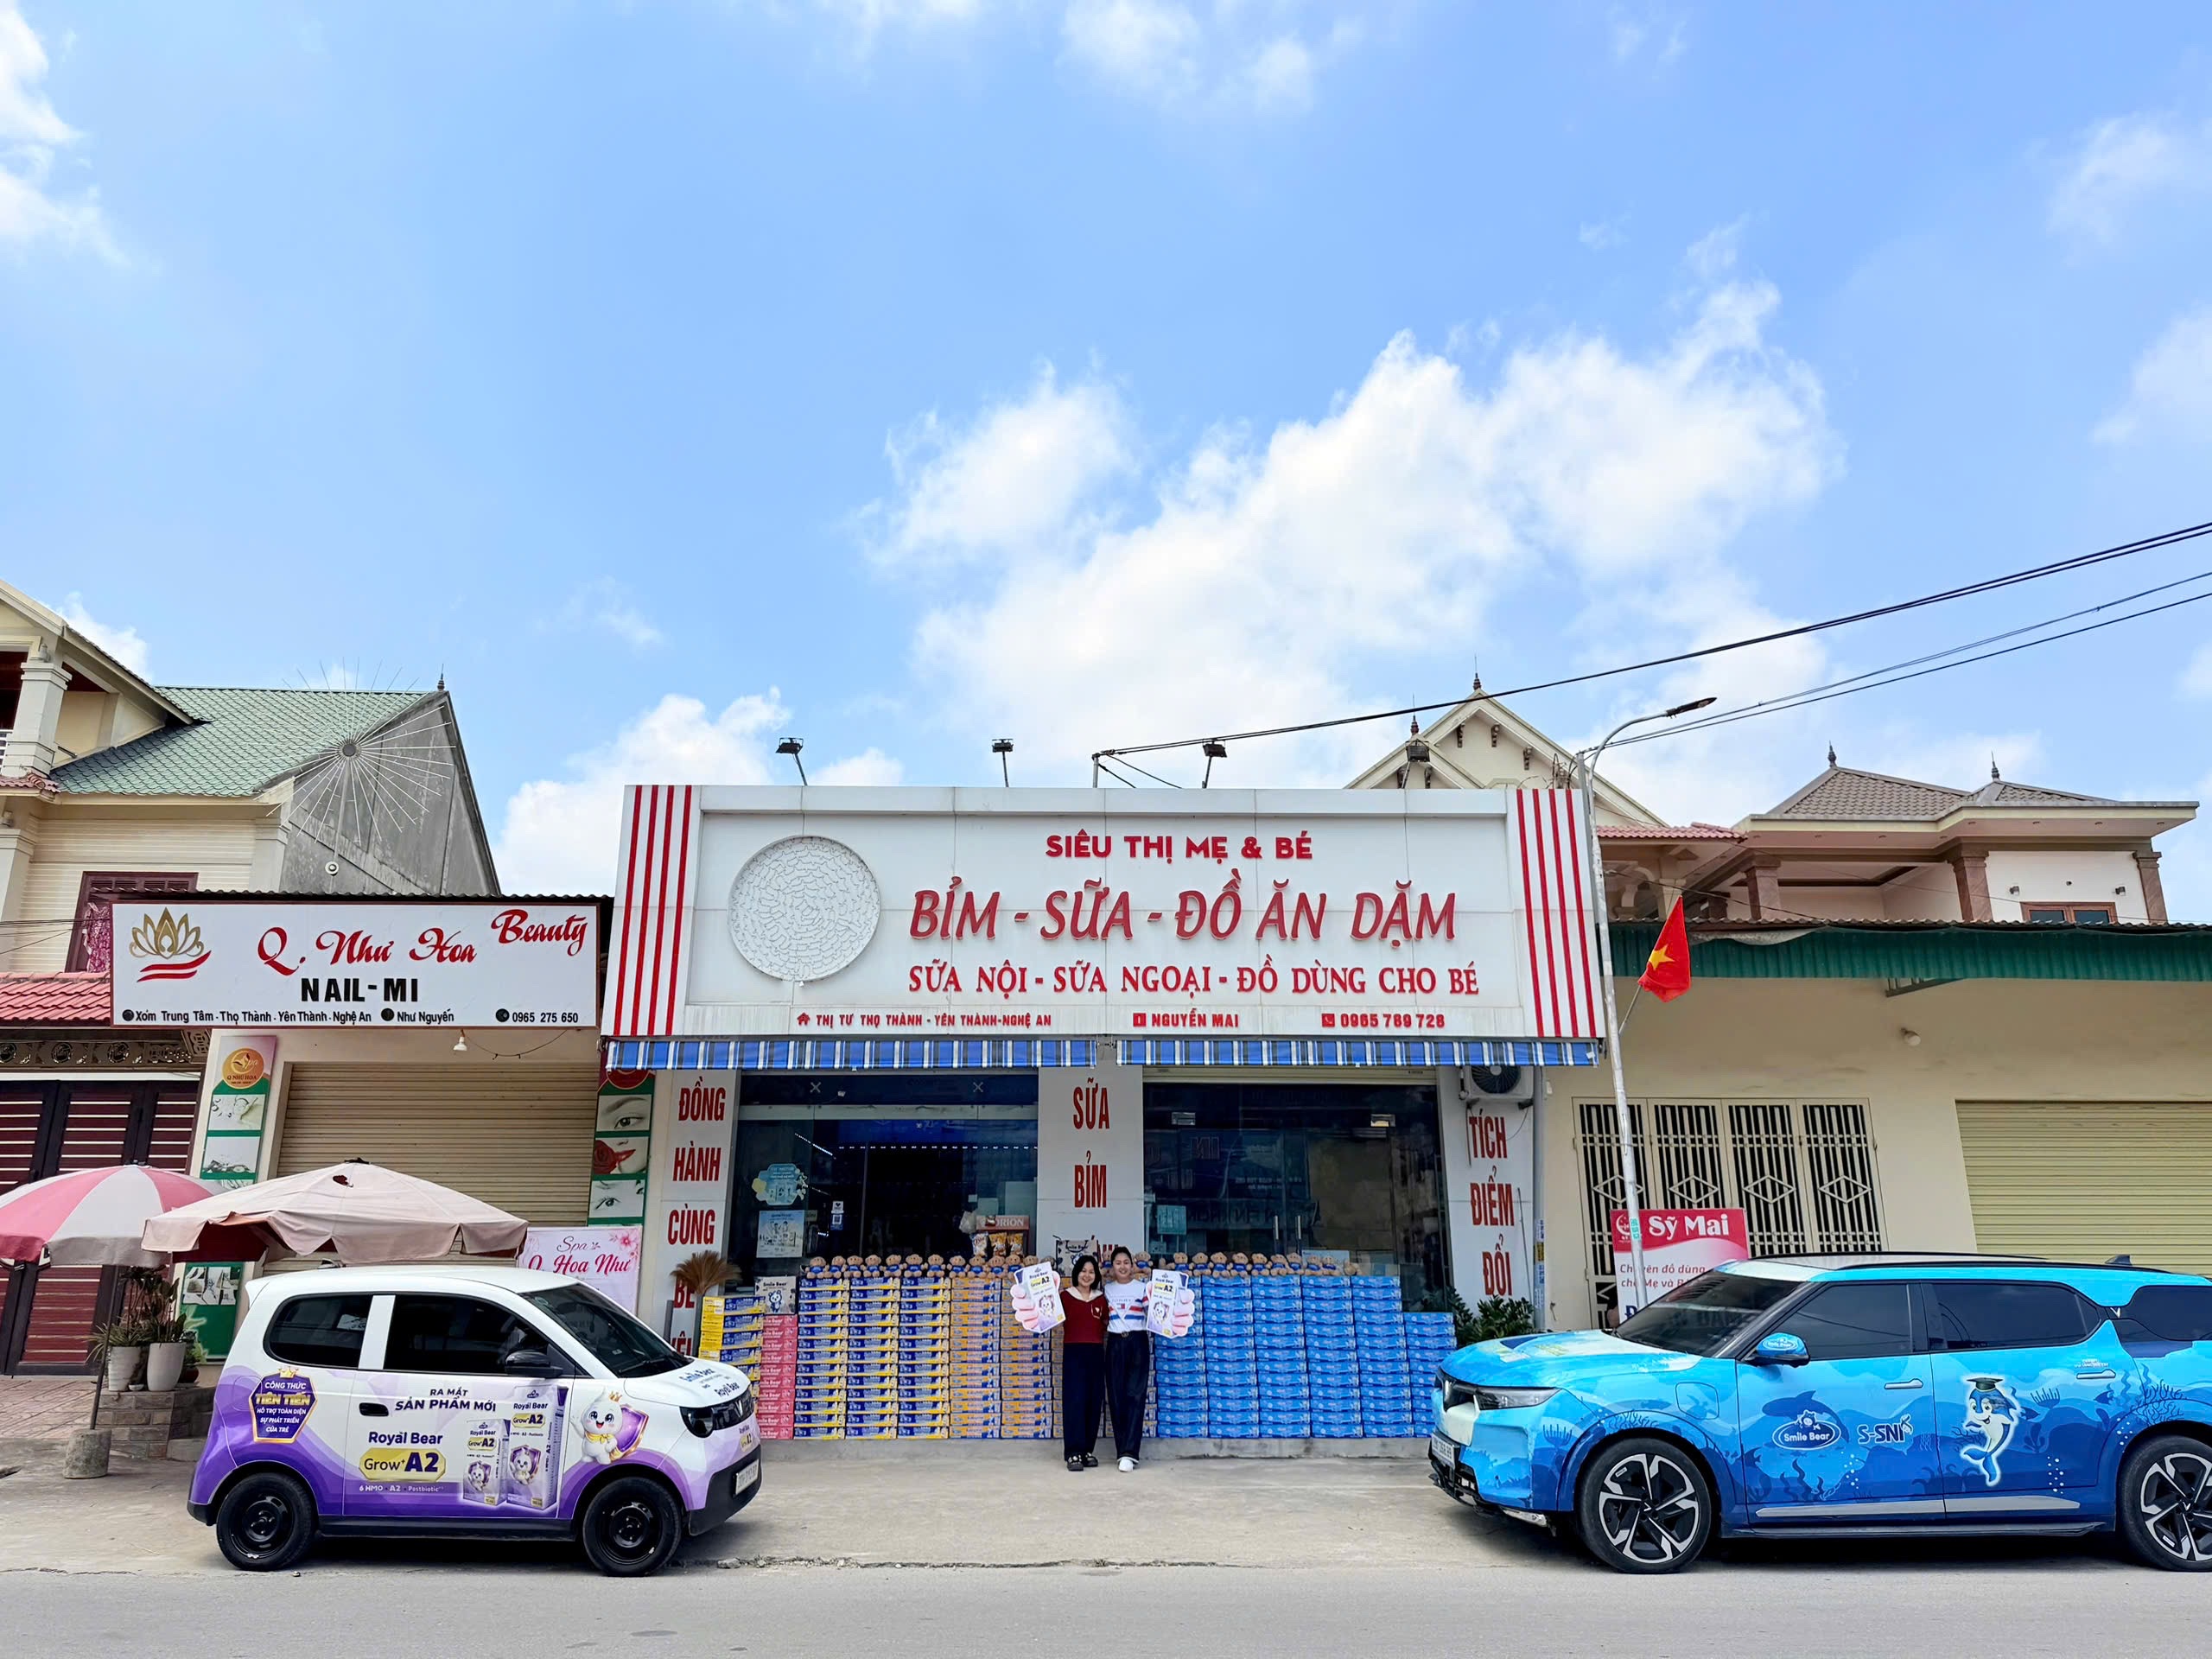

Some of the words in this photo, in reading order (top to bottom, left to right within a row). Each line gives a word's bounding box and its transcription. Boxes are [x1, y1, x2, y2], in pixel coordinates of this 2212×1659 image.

[1046, 829, 1113, 859] SIÊU
[1123, 836, 1173, 865] THỊ
[1185, 836, 1229, 865] MẸ
[1241, 836, 1262, 860] &
[1274, 830, 1313, 861] BÉ
[909, 875, 1001, 941] BỈM
[1039, 877, 1134, 941] SỮA
[1174, 868, 1243, 941] ĐỒ
[1255, 878, 1327, 941] ĂN
[1350, 880, 1457, 949] DẶM
[315, 931, 394, 966] Như
[409, 927, 478, 964] Hoa
[491, 908, 588, 957] Beauty
[909, 958, 963, 993] SỮA
[976, 959, 1028, 1001] NỘI
[1053, 960, 1108, 994] SỮA
[1121, 965, 1211, 999] NGOẠI
[1237, 955, 1279, 994] ĐỒ
[1291, 961, 1367, 995] DÙNG
[1378, 966, 1437, 995] CHO
[1448, 962, 1480, 996] BÉ
[161, 1010, 190, 1025] Trung
[193, 1009, 214, 1022] Tâm
[219, 1010, 239, 1026] Thọ
[241, 1010, 272, 1022] Thành
[277, 1010, 296, 1022] Yên
[296, 1010, 327, 1022] Thành
[333, 1010, 357, 1026] Nghệ
[359, 1011, 372, 1022] An
[397, 1011, 416, 1022] Như
[512, 1011, 536, 1023] 0965
[540, 1012, 557, 1023] 275
[561, 1012, 579, 1024] 650
[817, 1014, 834, 1028] THỊ
[861, 1014, 881, 1028] THỌ
[886, 1014, 924, 1027] THÀNH
[935, 1013, 956, 1027] YÊN
[1036, 1014, 1052, 1027] AN
[1211, 1014, 1240, 1028] MAI
[1416, 1013, 1446, 1029] 728
[679, 1077, 726, 1122] ĐỒNG
[1073, 1077, 1110, 1130] SỮA
[1469, 1109, 1508, 1159] TÍCH
[672, 1141, 721, 1182] HÀNH
[1074, 1150, 1108, 1209] BỈM
[1470, 1165, 1515, 1227] ĐIỂM
[667, 1204, 716, 1246] CÙNG
[1648, 1215, 1678, 1241] Sỹ
[1684, 1213, 1730, 1236] Mai
[556, 1236, 588, 1255] Spa
[552, 1254, 589, 1275] Hoa
[594, 1253, 632, 1277] Như
[1481, 1234, 1513, 1297] ĐỔI
[1619, 1263, 1659, 1274] Chên
[1661, 1278, 1674, 1287] và
[264, 1380, 285, 1389] CÔNG
[286, 1380, 307, 1389] THỨC
[447, 1386, 468, 1396] MẮT
[255, 1391, 282, 1405] TIÊN
[283, 1390, 311, 1406] TIẾN
[394, 1395, 425, 1411] SẢN
[429, 1395, 471, 1410] PHẨM
[474, 1399, 497, 1412] MỚI
[529, 1414, 543, 1424] A2
[368, 1430, 408, 1446] Royal
[410, 1431, 443, 1445] Bear
[481, 1438, 495, 1447] A2
[1783, 1432, 1808, 1442] Smile
[1808, 1432, 1831, 1441] Bear
[404, 1451, 441, 1473] A2
